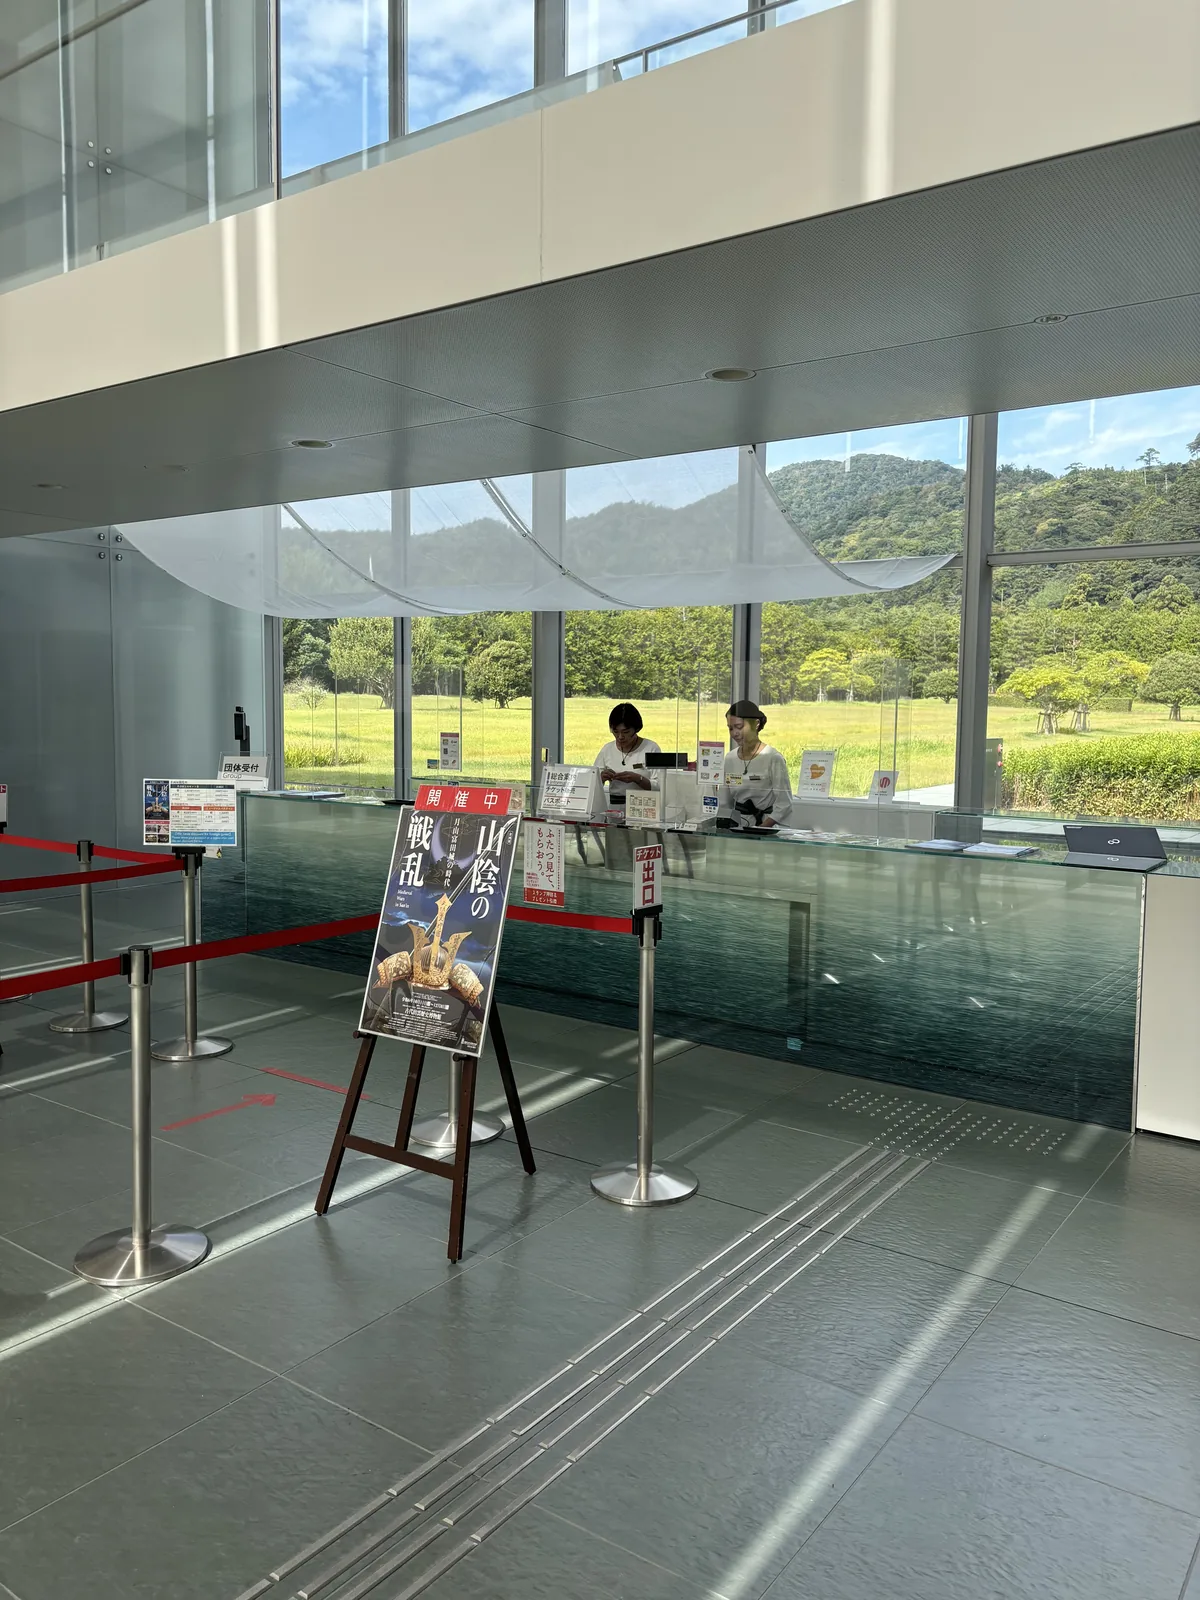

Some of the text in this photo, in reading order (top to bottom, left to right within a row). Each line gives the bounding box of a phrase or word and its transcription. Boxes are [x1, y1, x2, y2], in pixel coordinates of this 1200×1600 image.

[222, 772, 242, 780] Group
[224, 763, 259, 773] 団体受付
[426, 789, 498, 809] 開催中
[399, 815, 434, 887] 戦乱
[469, 820, 505, 919] 山陰の
[536, 827, 545, 877] もらおう。
[545, 828, 555, 888] ふたつ見て、
[636, 847, 661, 860] チケット
[642, 860, 655, 906] 出口
